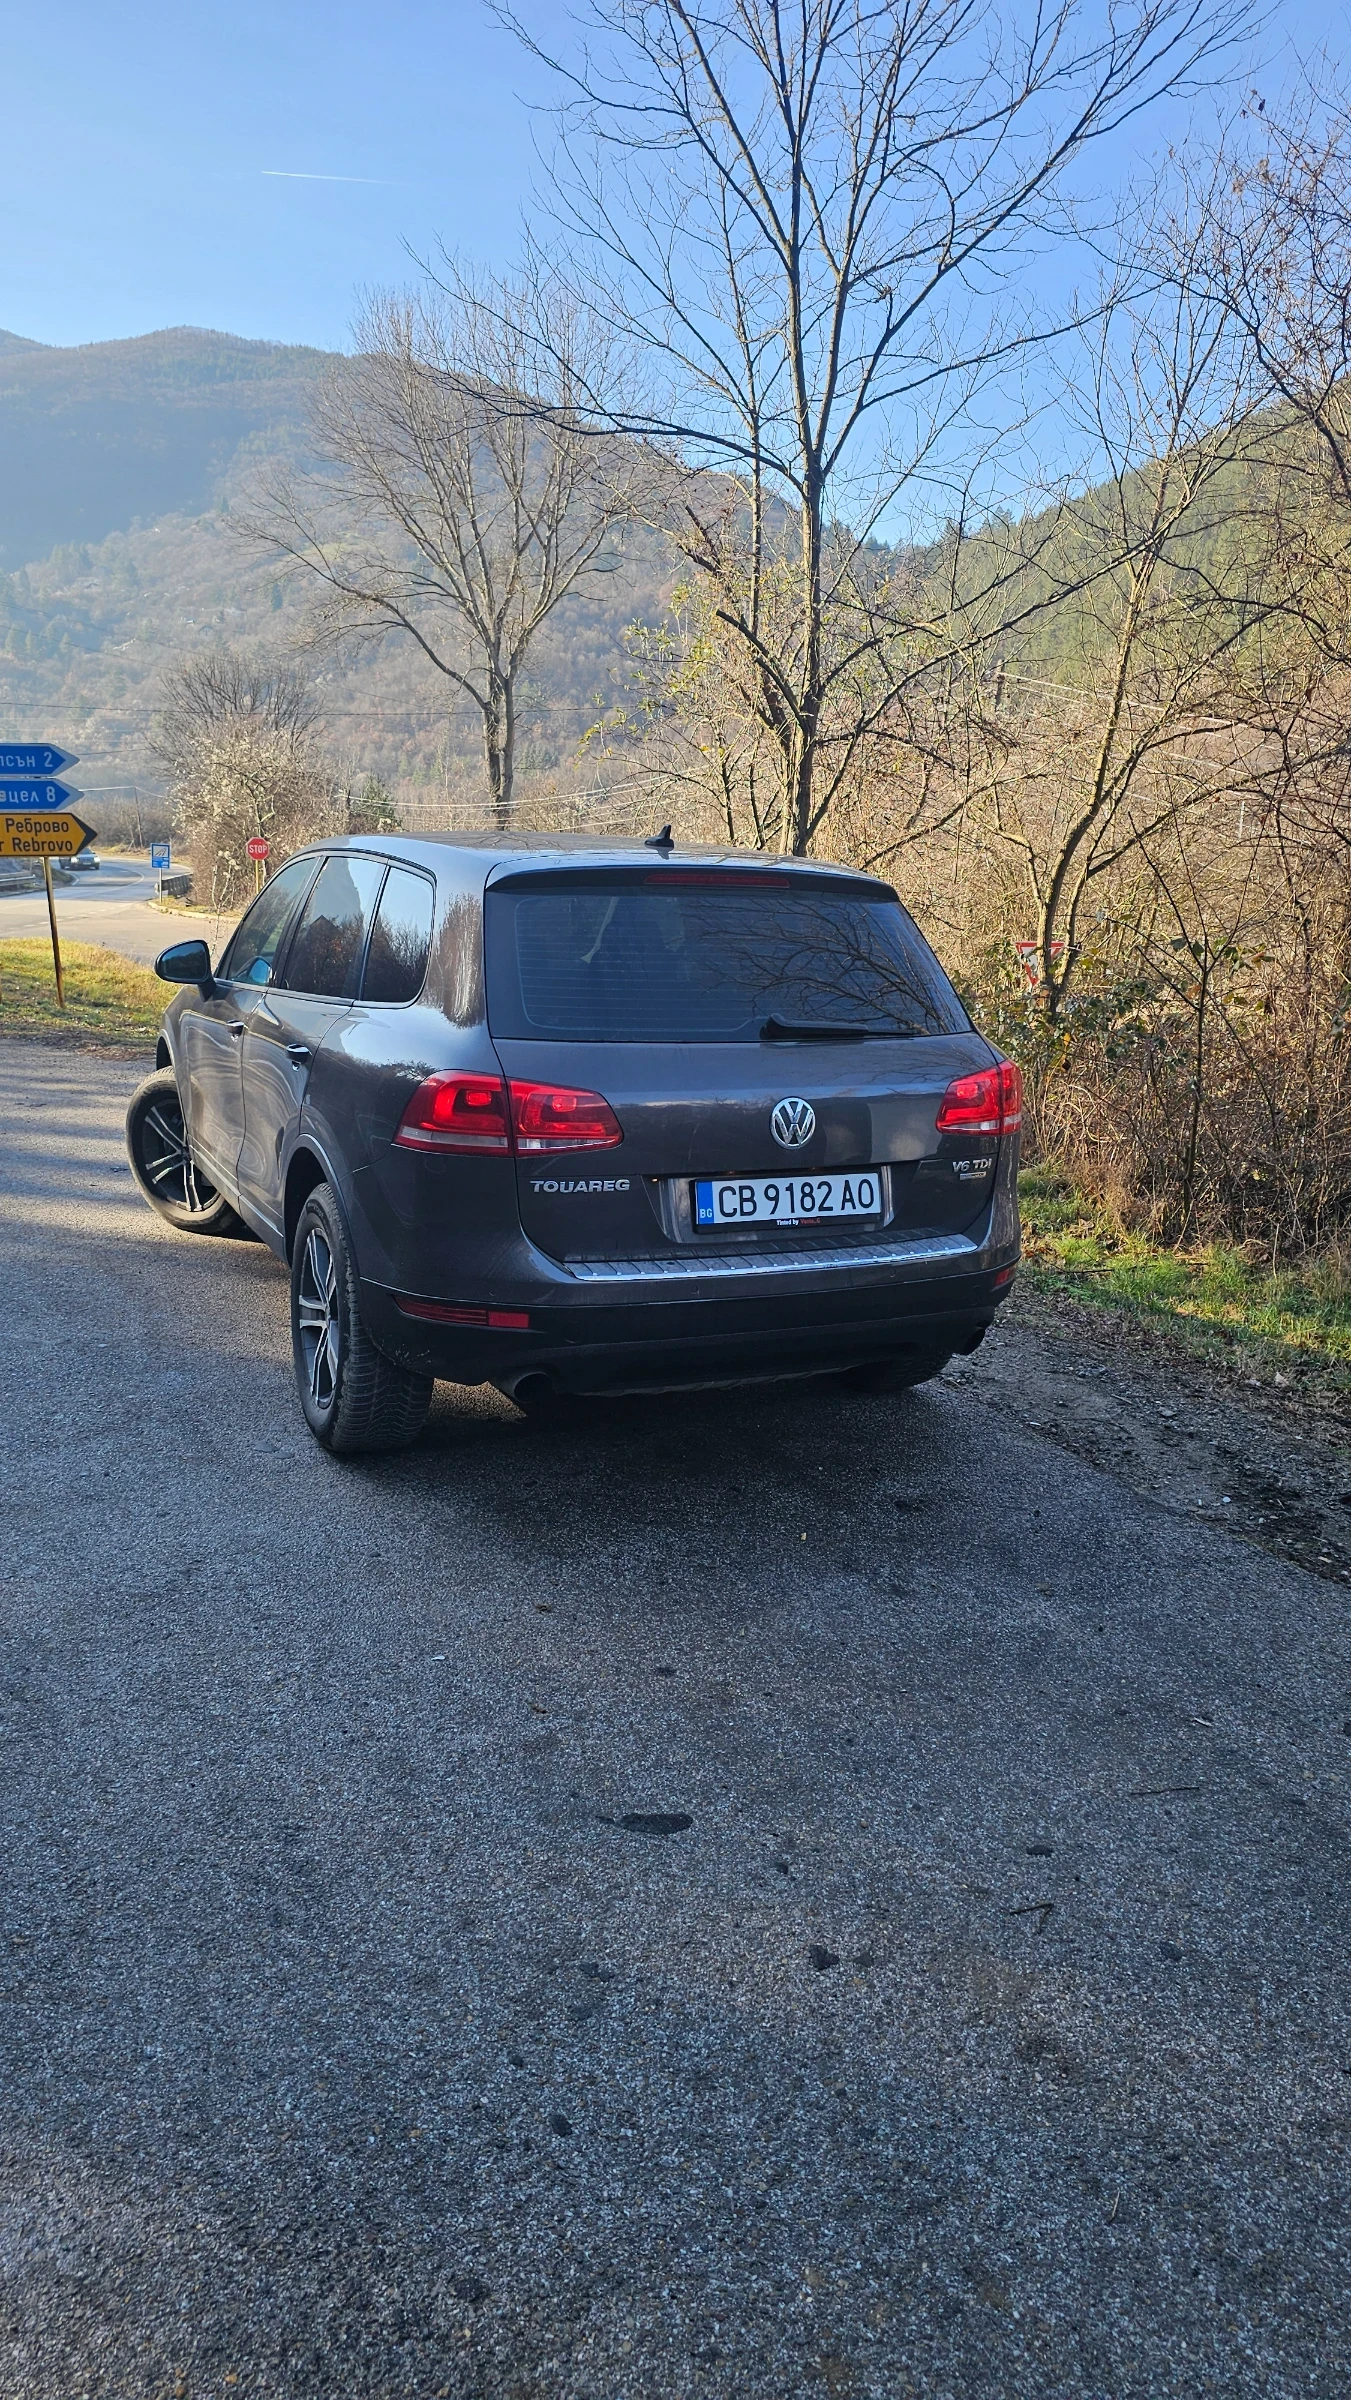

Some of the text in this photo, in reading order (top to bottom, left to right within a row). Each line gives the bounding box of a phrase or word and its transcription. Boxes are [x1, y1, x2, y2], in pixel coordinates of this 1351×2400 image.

[43, 751, 53, 767] 2
[46, 786, 56, 802] 8
[5, 817, 69, 836] Реброво
[12, 837, 73, 852] Rebrovo
[249, 844, 268, 854] STOP
[952, 1158, 992, 1172] V6 TDI
[530, 1179, 630, 1193] TOUAREG
[718, 1185, 757, 1218] CB
[763, 1180, 834, 1215] 9182
[700, 1208, 713, 1219] BG
[792, 1218, 800, 1226] by
